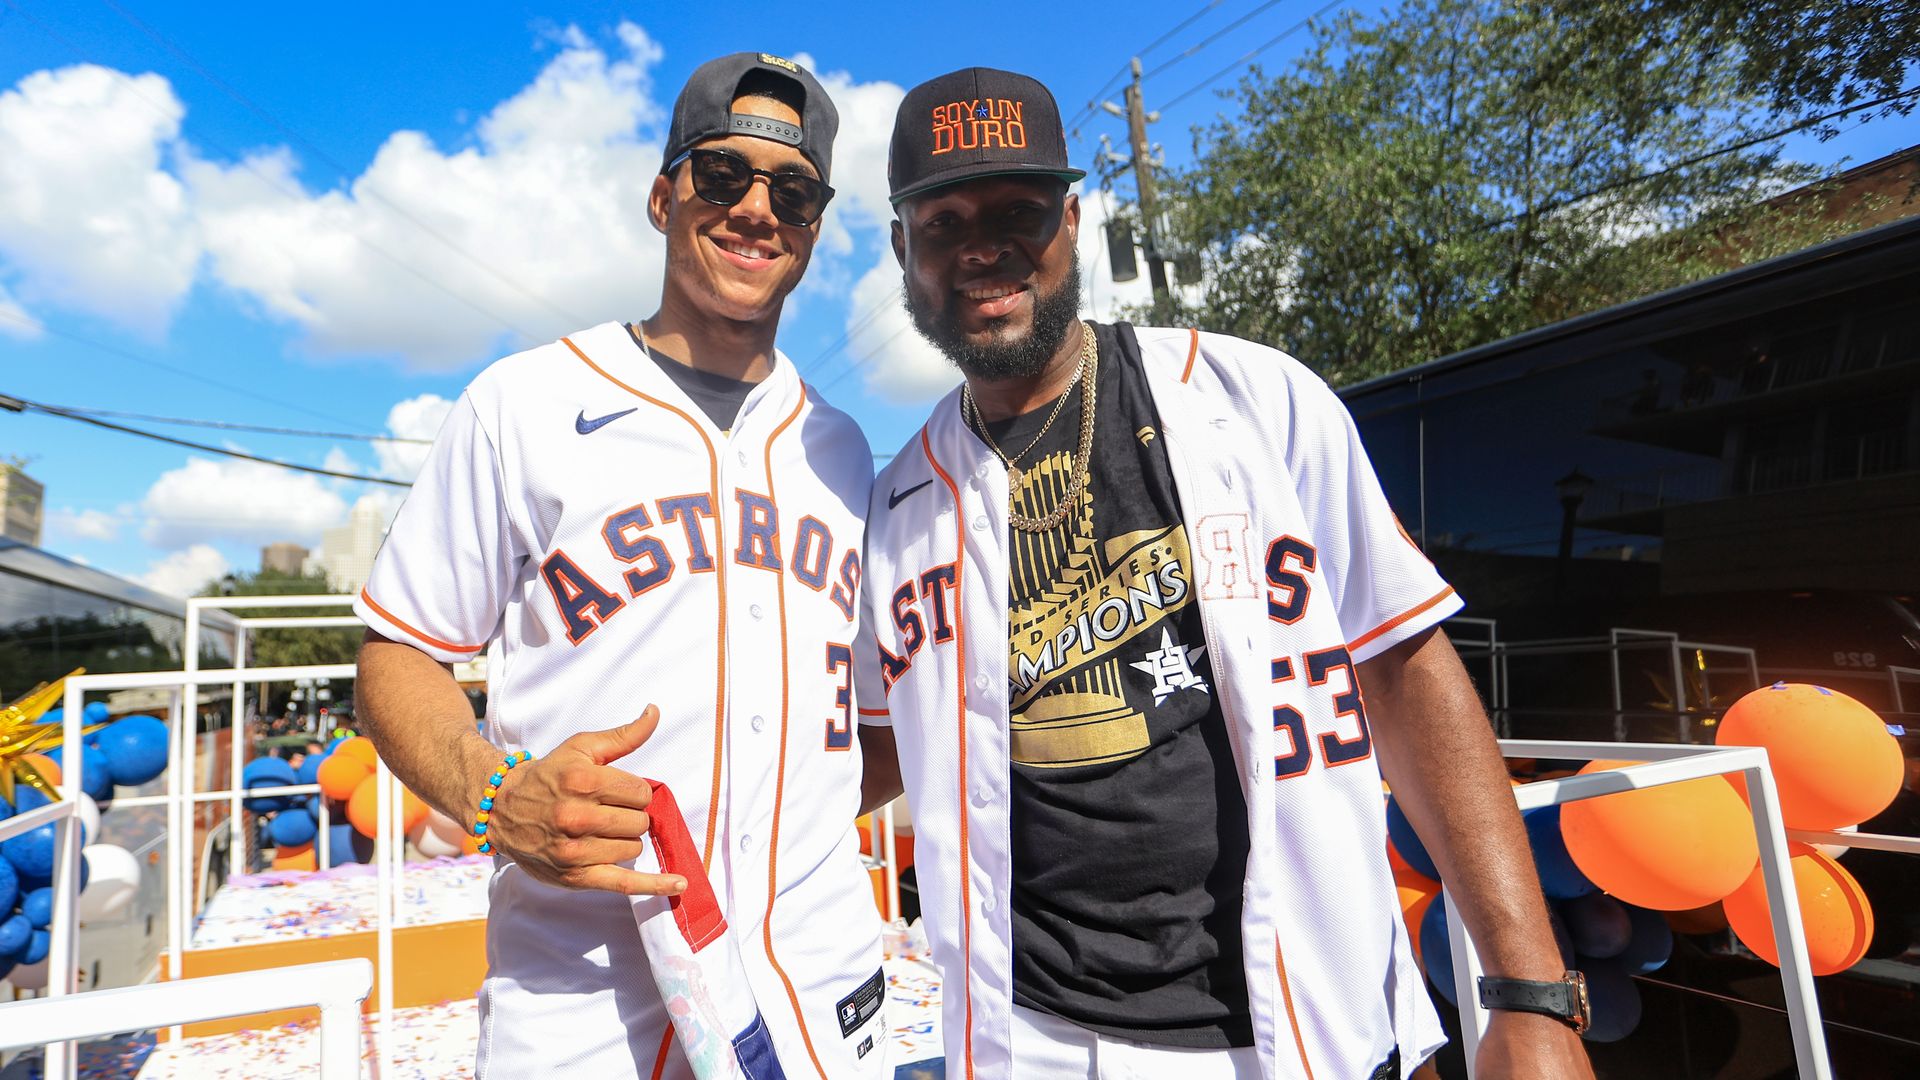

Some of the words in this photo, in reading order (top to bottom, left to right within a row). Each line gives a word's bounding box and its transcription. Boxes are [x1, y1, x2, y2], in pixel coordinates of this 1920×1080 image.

[932, 99, 979, 127] SOY
[986, 98, 1022, 122] UN
[931, 120, 1027, 155] DURO
[540, 487, 862, 647] ASTROS
